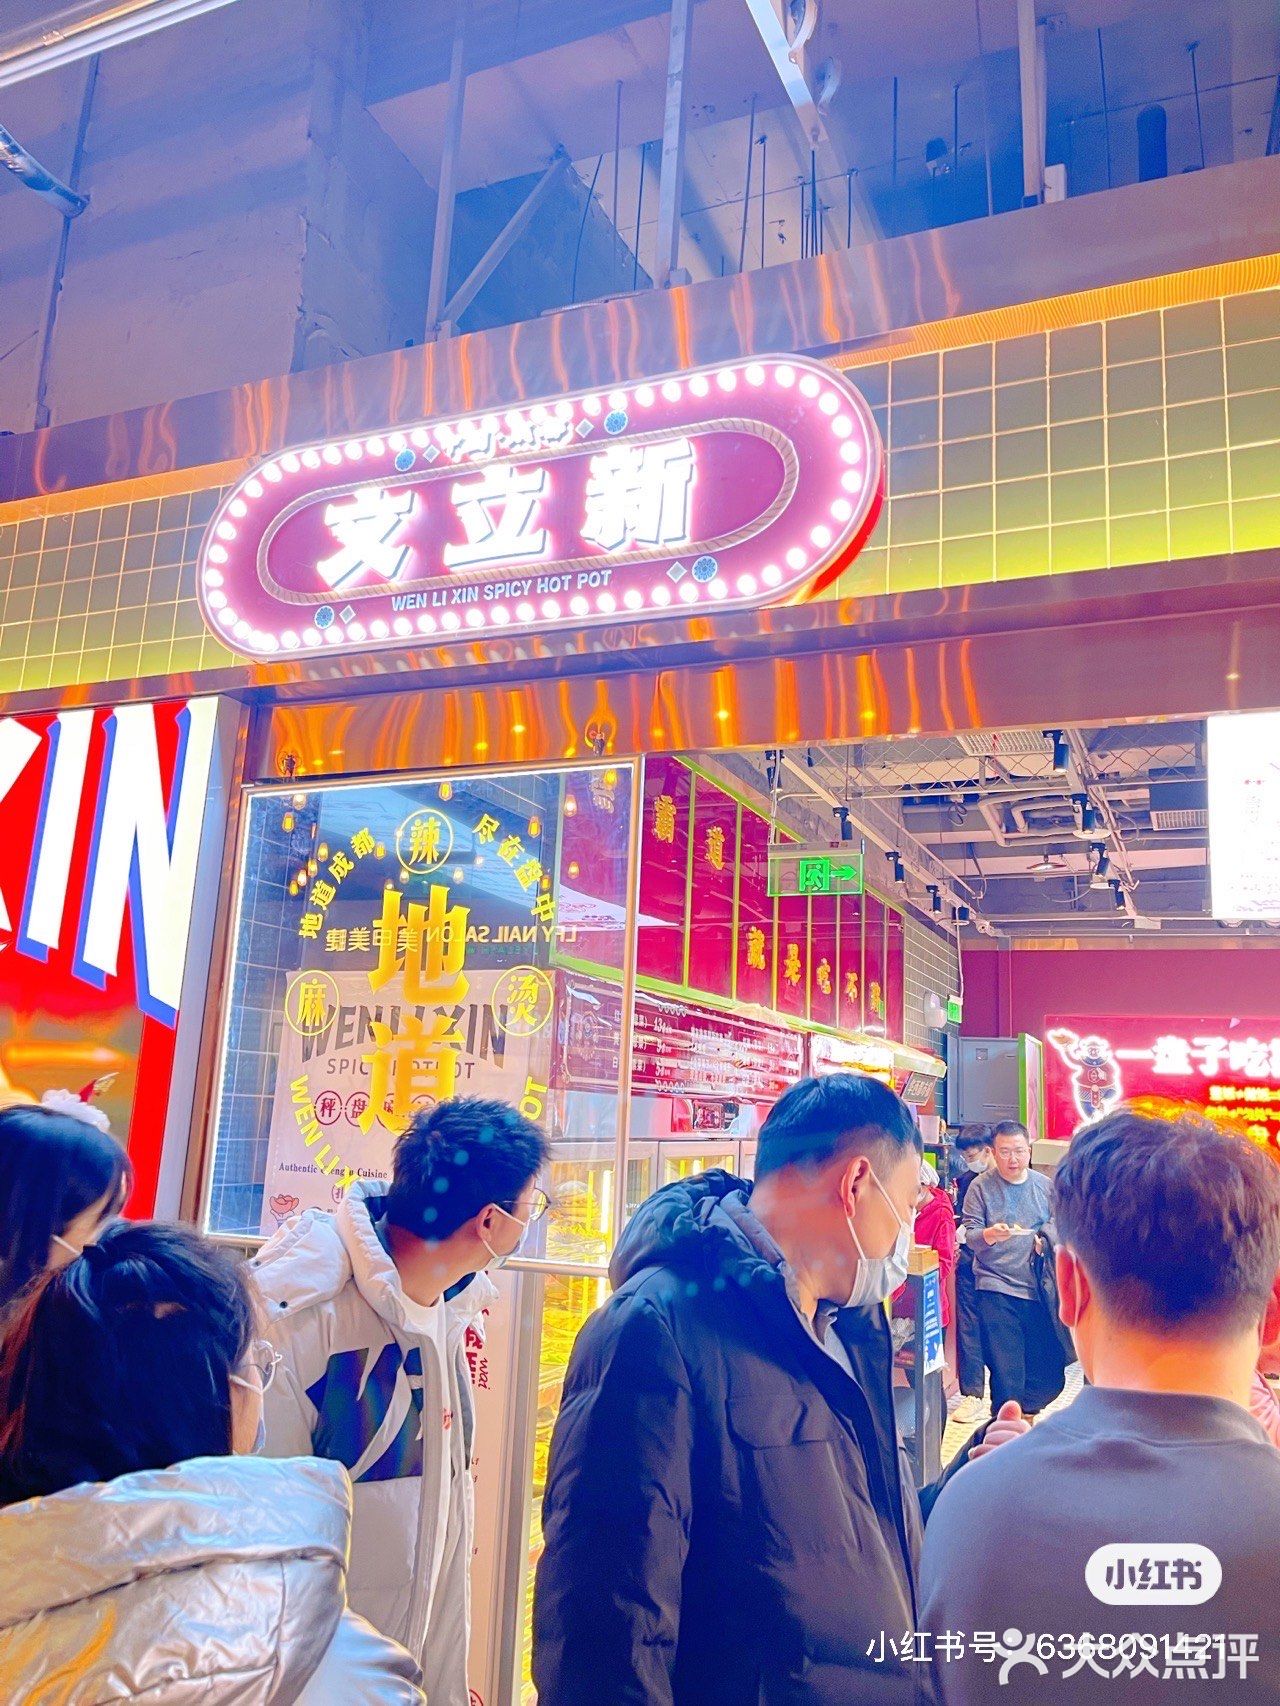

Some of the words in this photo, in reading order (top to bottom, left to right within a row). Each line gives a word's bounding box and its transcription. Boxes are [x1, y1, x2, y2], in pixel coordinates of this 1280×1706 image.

[316, 438, 694, 590] 文立新
[391, 592, 428, 612] WEN
[432, 591, 447, 607] LI
[451, 586, 479, 605] XIN
[483, 579, 532, 600] SPICY
[537, 574, 572, 593] HOT
[577, 570, 612, 589] POT
[408, 817, 441, 866] 辣
[298, 827, 376, 940] 地道成都
[296, 976, 328, 1026] 麻
[362, 885, 471, 1136] 地道
[504, 973, 540, 1027] 烫
[326, 1058, 380, 1077] SPIC
[290, 1073, 324, 1147] WEN
[519, 1075, 548, 1121] OT
[278, 1162, 318, 1175] Authentic
[357, 1167, 388, 1179] Cuisine
